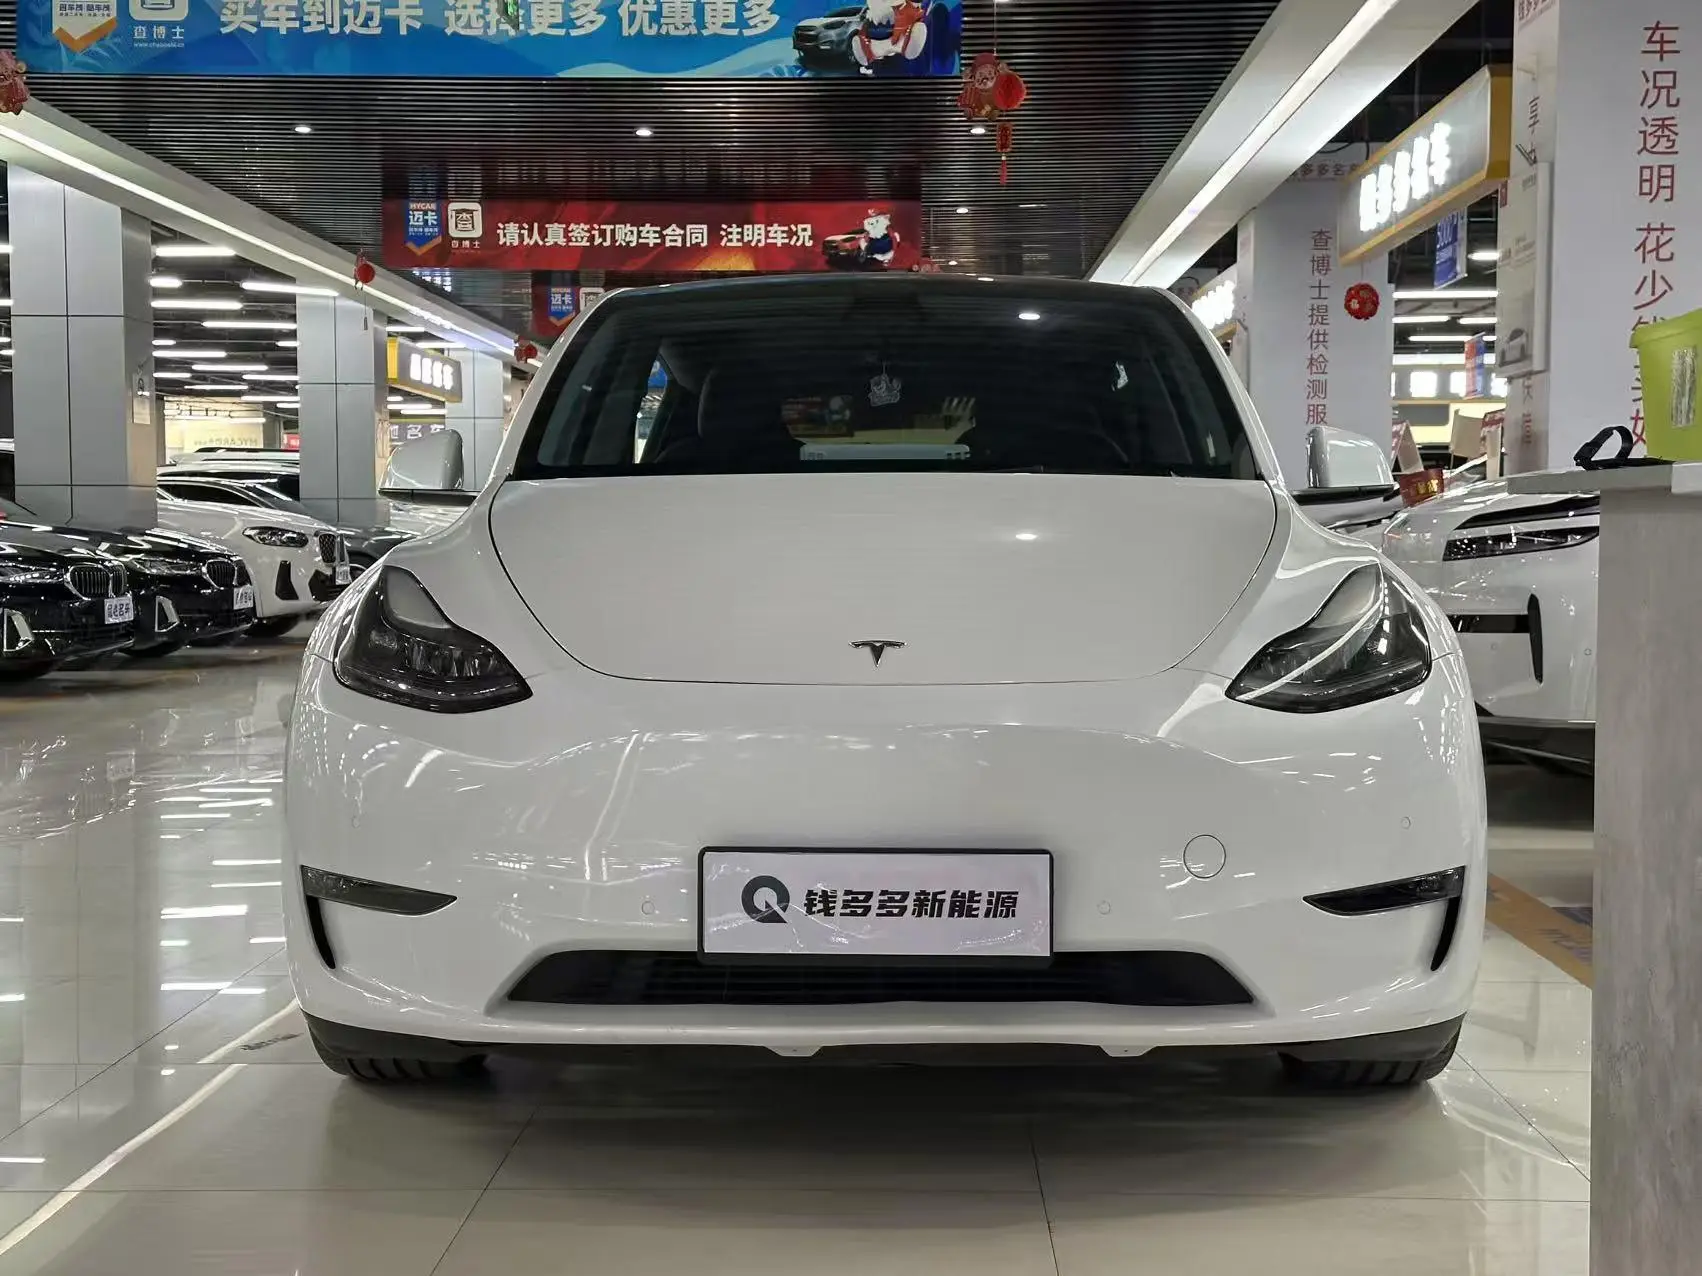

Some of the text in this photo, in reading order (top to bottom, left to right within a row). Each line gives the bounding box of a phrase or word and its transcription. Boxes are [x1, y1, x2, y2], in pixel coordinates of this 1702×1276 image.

[220, 0, 424, 35] 买车到迈卡
[618, 0, 780, 36] 优惠更多
[1637, 21, 1680, 203] 车况透明
[409, 211, 438, 226] 迈卡
[497, 223, 813, 247] 请认真签订购车合同 注明车况
[803, 889, 1019, 919] 钱多多新能源
